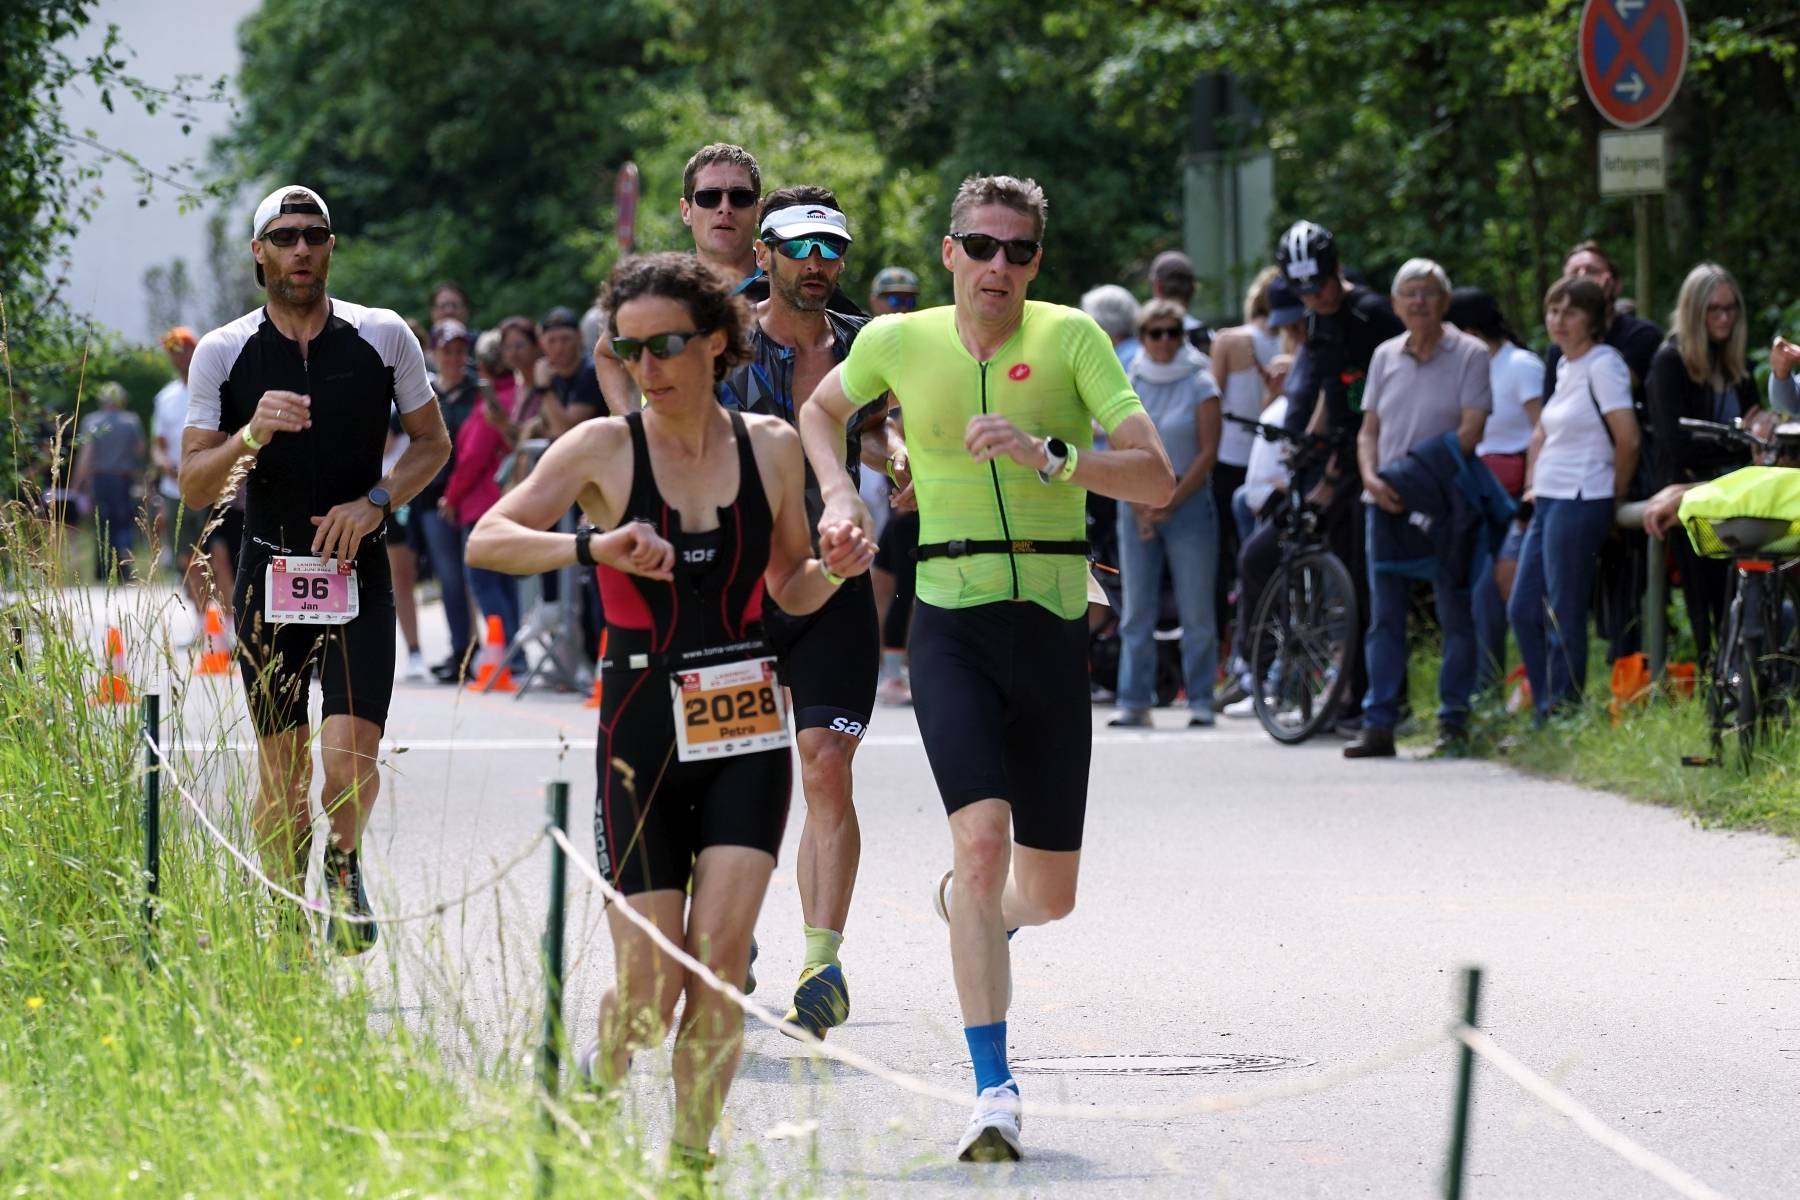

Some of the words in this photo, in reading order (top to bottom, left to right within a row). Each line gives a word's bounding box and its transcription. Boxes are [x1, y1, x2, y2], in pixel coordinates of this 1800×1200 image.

[253, 536, 292, 553] orca
[292, 577, 329, 599] 96
[301, 602, 318, 610] Jan
[686, 687, 776, 727] 2028
[720, 726, 756, 738] Petra
